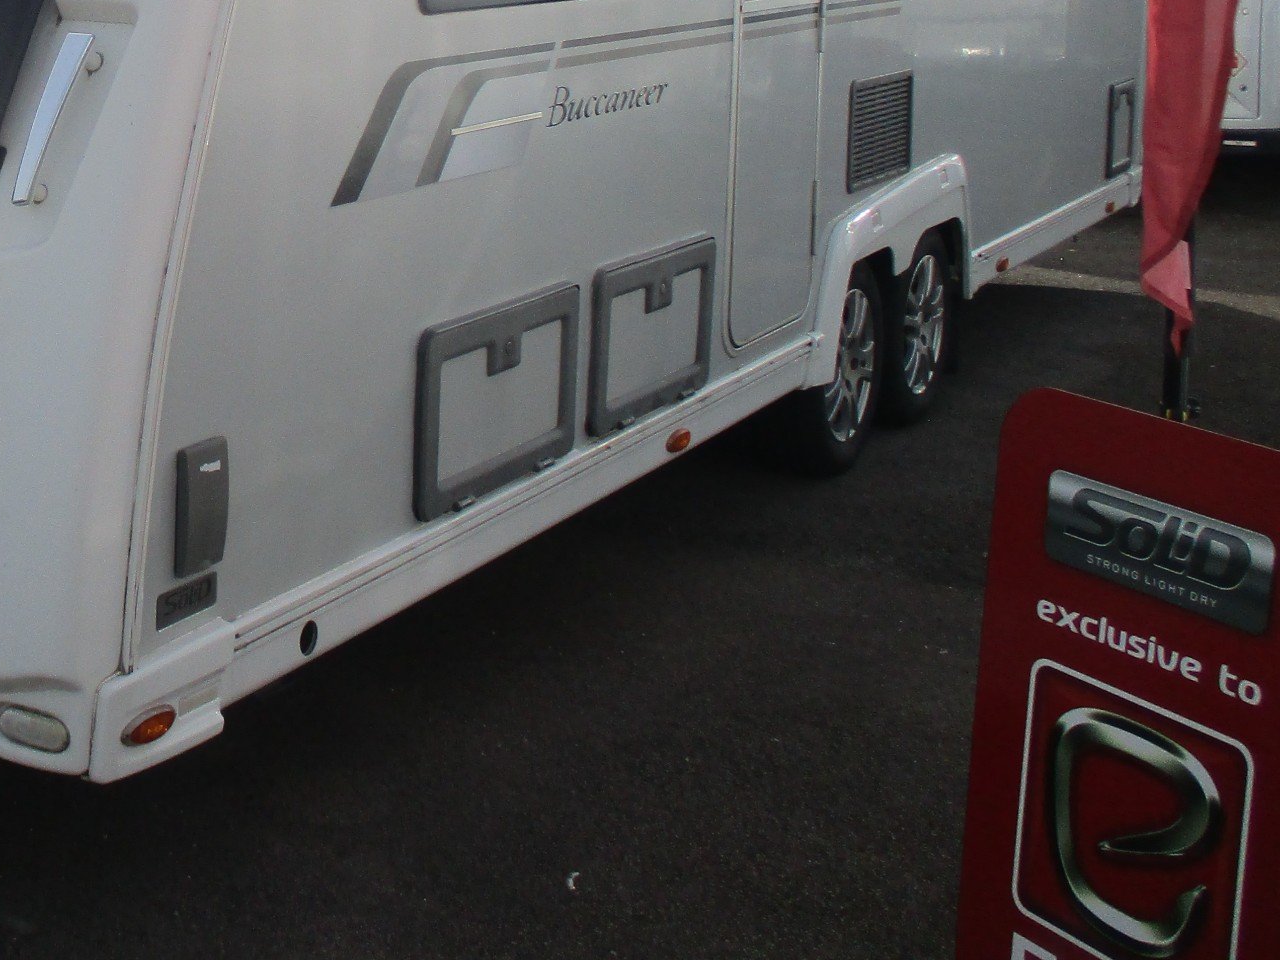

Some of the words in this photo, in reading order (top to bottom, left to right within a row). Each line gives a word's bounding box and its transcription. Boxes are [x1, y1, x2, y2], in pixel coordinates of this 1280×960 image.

[545, 81, 669, 128] Buccaneer
[1086, 553, 1139, 580] STRONG
[1144, 574, 1185, 597] LIGHT
[1189, 590, 1218, 608] DRY
[1036, 598, 1202, 683] exclusive
[1218, 663, 1262, 706] to
